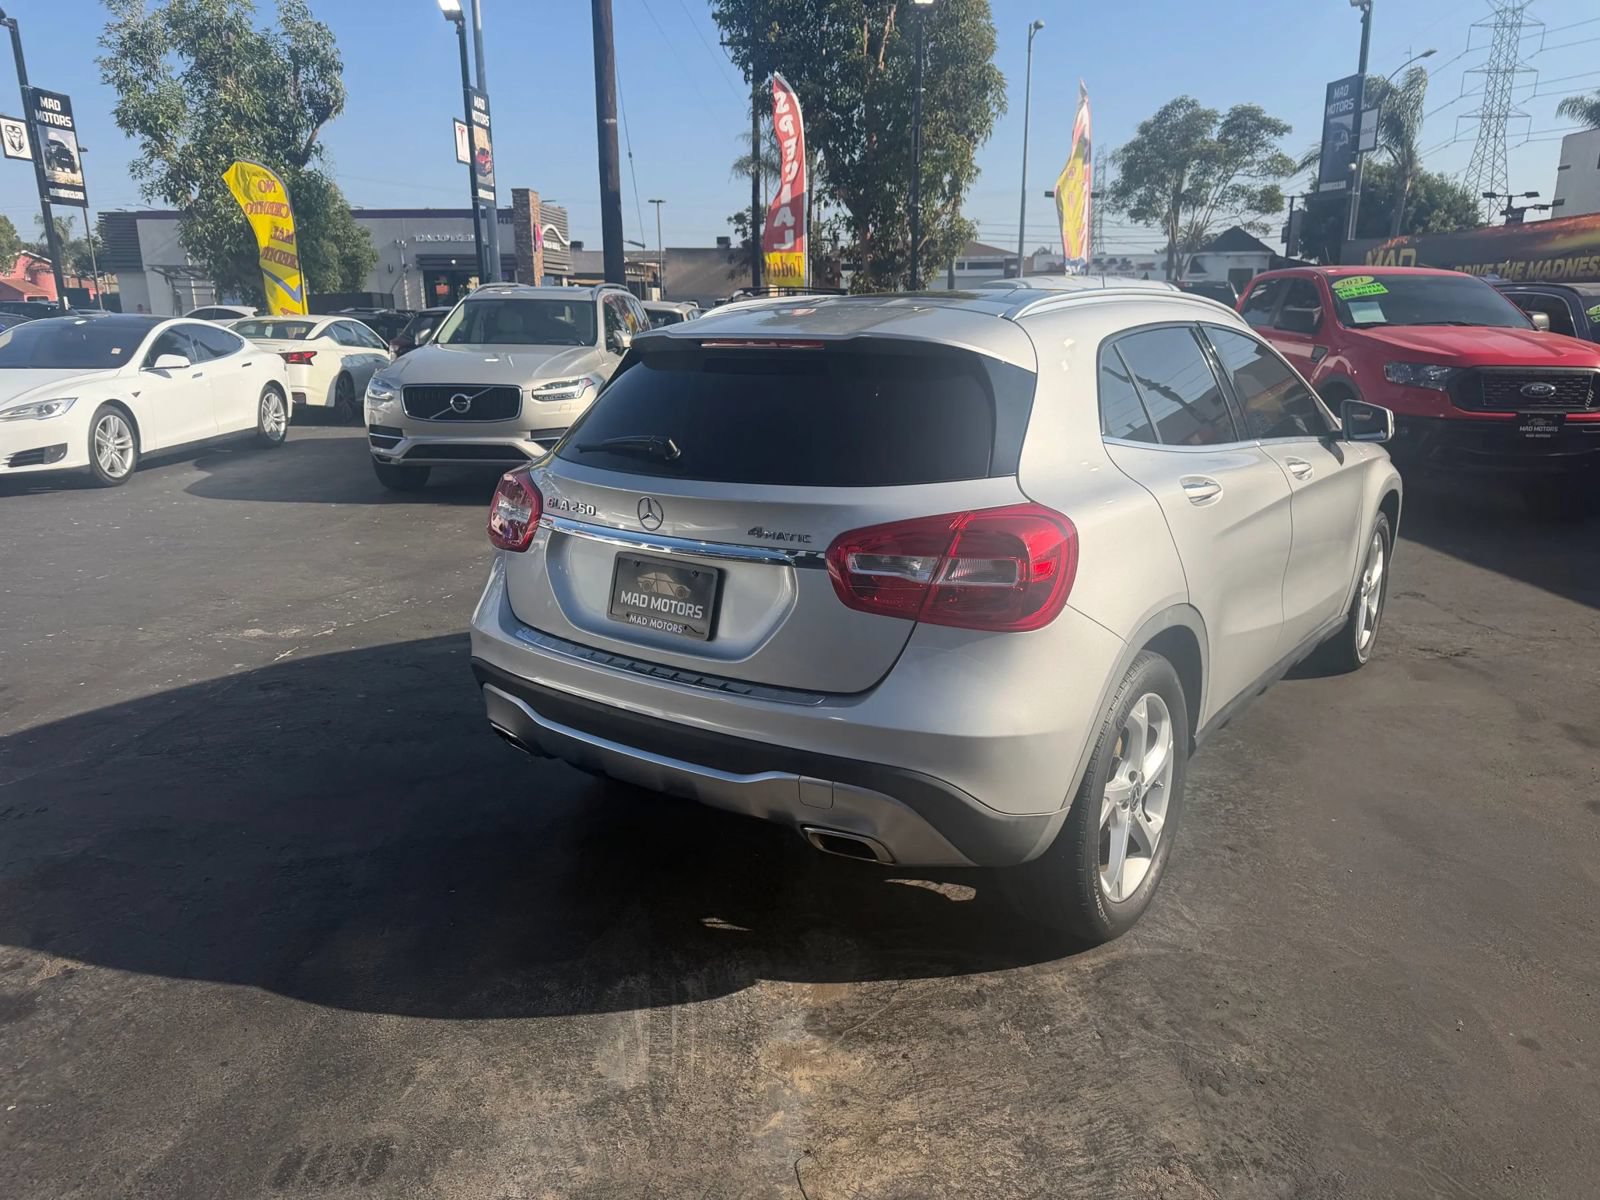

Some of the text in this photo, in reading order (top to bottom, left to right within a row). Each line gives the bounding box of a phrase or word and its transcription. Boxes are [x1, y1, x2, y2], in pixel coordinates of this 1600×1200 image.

[1333, 85, 1350, 99] MAD
[40, 96, 61, 111] MAD
[473, 96, 485, 111] MAD
[1326, 98, 1355, 117] MOTORS
[35, 109, 73, 128] MOTORS
[1366, 247, 1417, 267] MAD
[1497, 261, 1526, 280] THE
[1525, 255, 1600, 280] MADNES
[547, 497, 597, 516] GLA 250
[747, 525, 813, 543] 4MATIC
[620, 590, 704, 619] MAD MOTORS
[629, 614, 683, 634] MAD MOTORS
